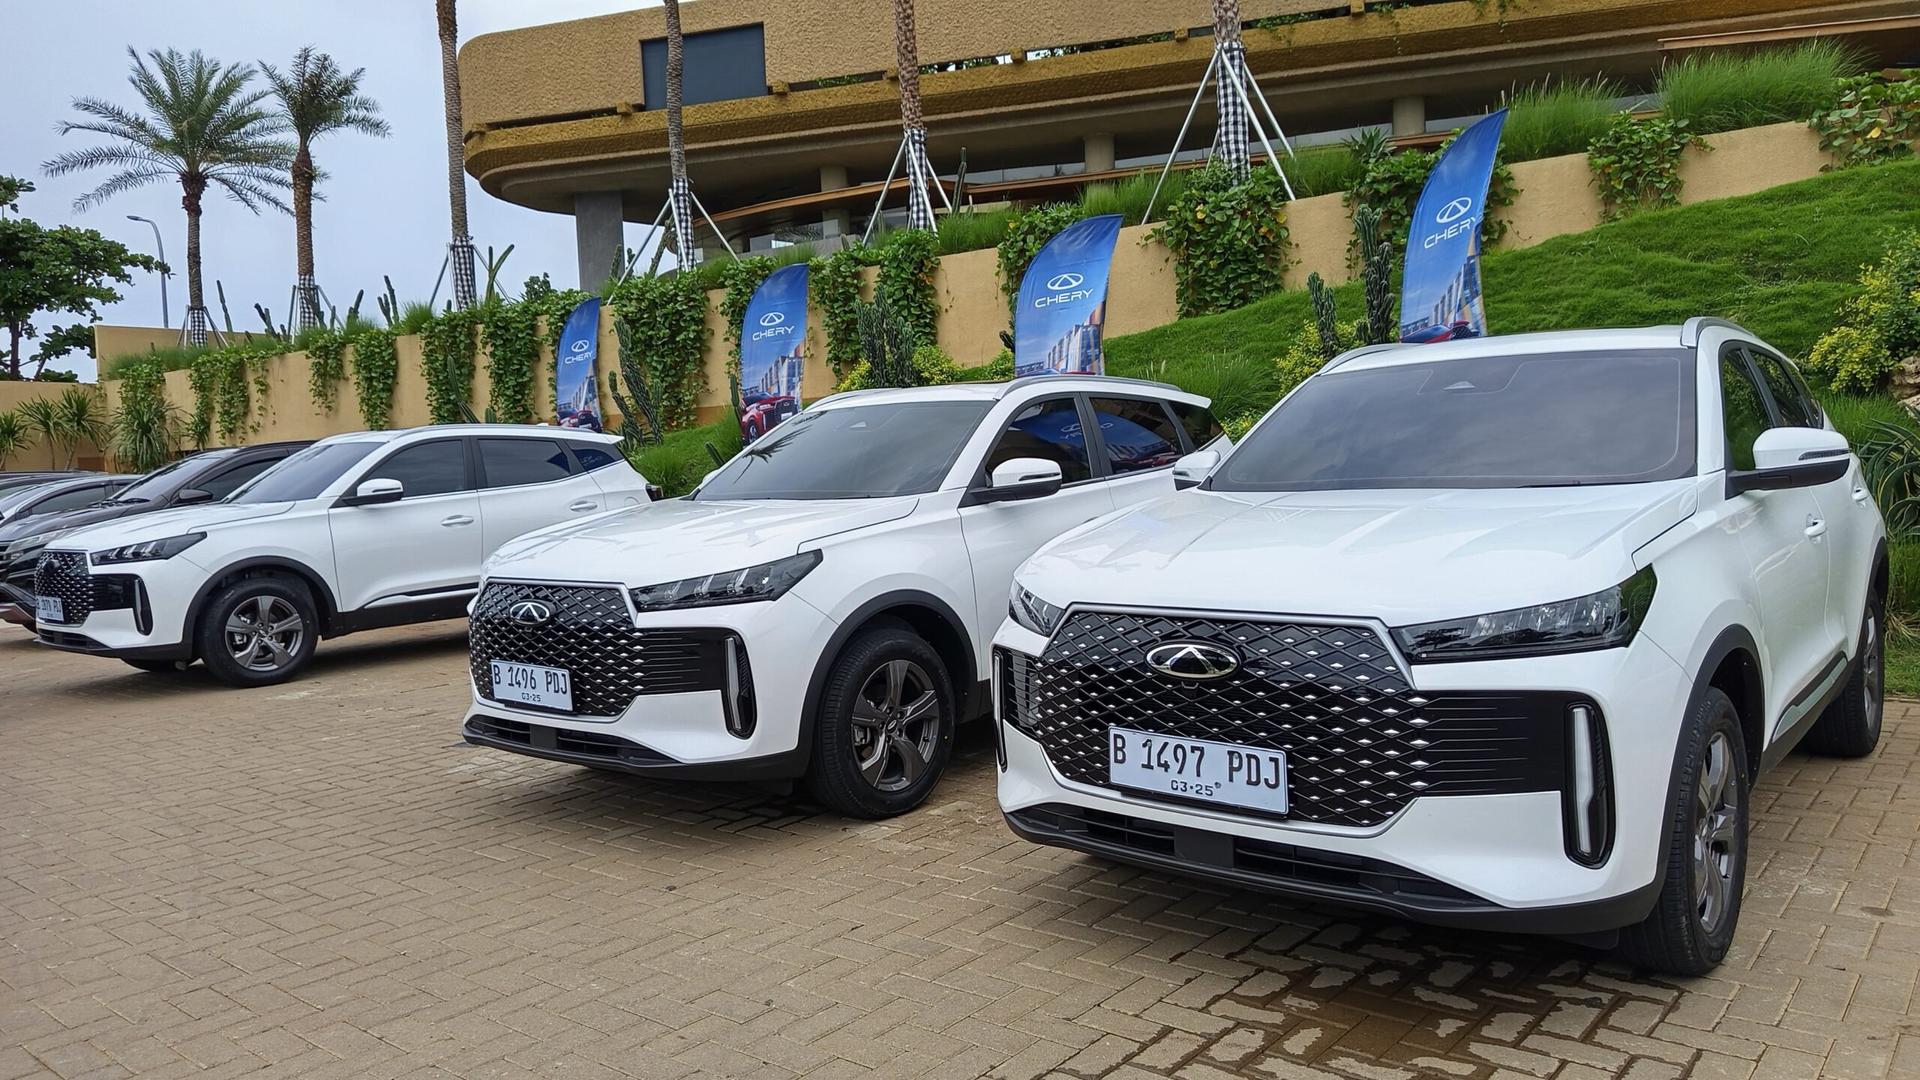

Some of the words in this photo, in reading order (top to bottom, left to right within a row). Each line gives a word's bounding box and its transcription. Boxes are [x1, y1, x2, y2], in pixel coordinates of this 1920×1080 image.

[1035, 288, 1094, 308] CHERY
[752, 325, 795, 341] CHERY
[565, 351, 593, 364] CHERY
[493, 664, 501, 684] B
[508, 666, 537, 689] 1496
[545, 670, 567, 694] PDJ
[1113, 733, 1126, 764] B
[1141, 738, 1205, 777] 1497
[1227, 750, 1280, 789] PDJ
